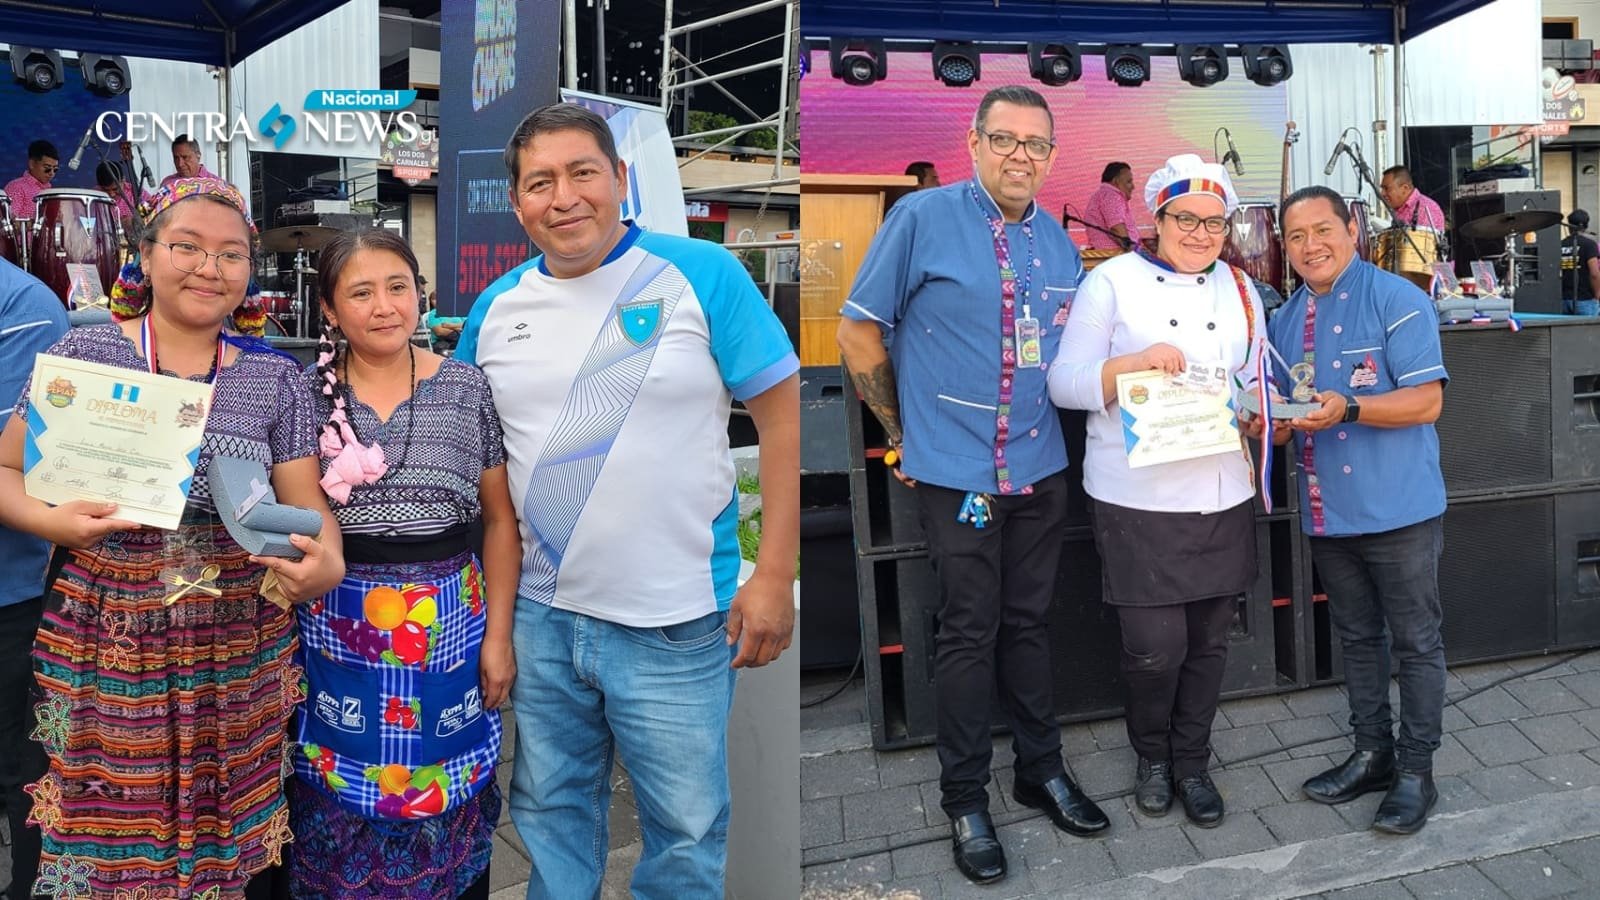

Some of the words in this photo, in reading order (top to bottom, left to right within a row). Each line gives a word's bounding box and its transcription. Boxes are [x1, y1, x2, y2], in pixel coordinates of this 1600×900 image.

[396, 158, 429, 167] CARNALES
[507, 333, 532, 343] umbro
[86, 398, 159, 425] DIPLOMA
[344, 699, 359, 718] Z
